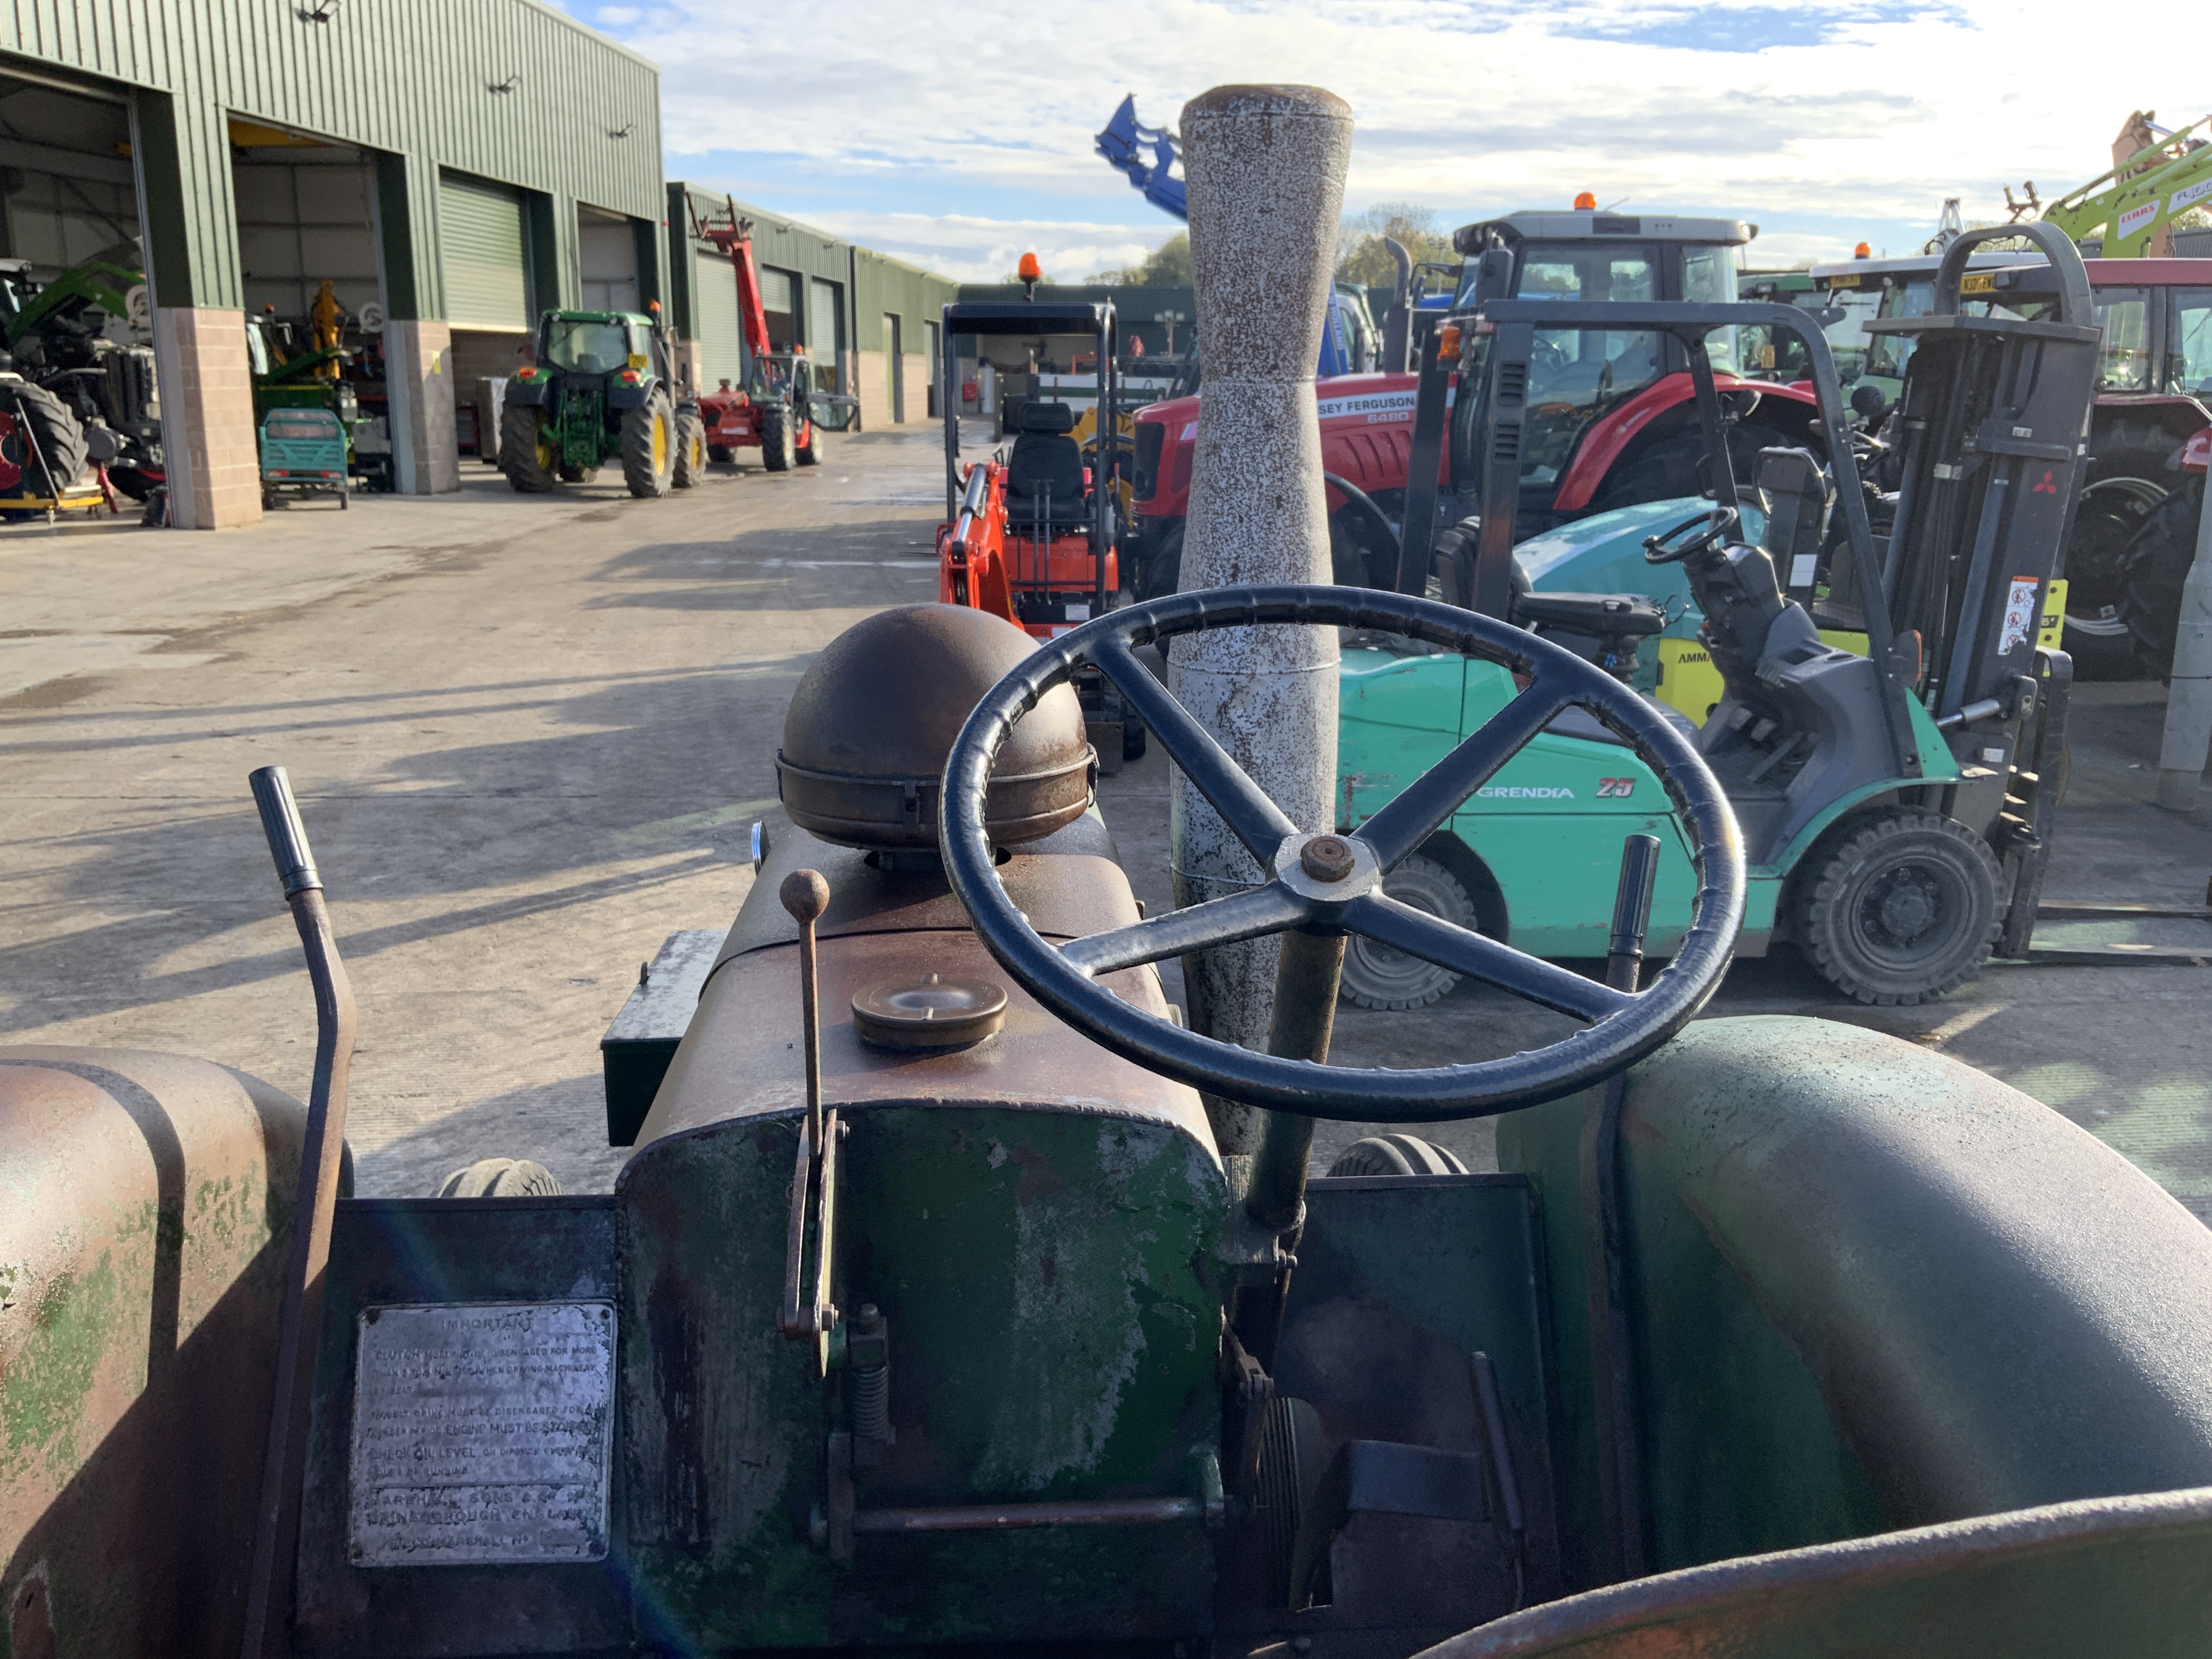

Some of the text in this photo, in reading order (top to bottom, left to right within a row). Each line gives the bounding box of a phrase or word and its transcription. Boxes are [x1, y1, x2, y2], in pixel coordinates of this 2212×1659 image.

[2121, 204, 2155, 224] CLAAS
[1347, 397, 1414, 412] FERGUSON
[1367, 411, 1409, 424] 6480
[1595, 777, 1637, 798] 25
[442, 1318, 533, 1331] IMPORTANT
[495, 1406, 558, 1416] DISENGAGED
[490, 1423, 523, 1434] MUST
[439, 1447, 476, 1458] LEVEL
[483, 1448, 496, 1457] ON
[469, 1492, 514, 1504] SONS
